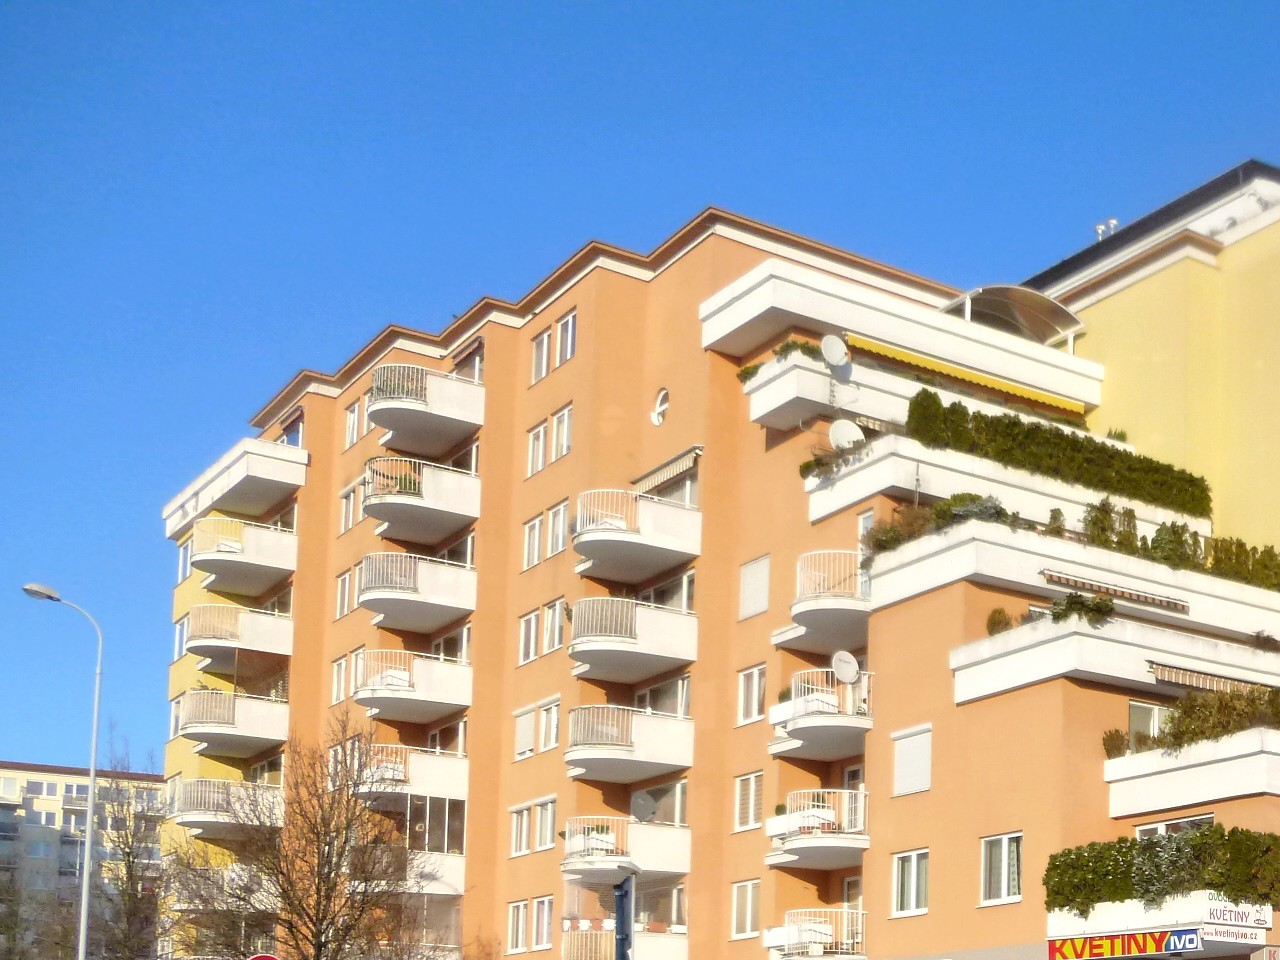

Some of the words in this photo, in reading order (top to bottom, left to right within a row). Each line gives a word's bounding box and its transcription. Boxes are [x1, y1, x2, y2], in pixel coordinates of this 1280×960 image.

[1209, 906, 1250, 923] KVĚTINY
[1049, 931, 1170, 960] KVĚTINY
[1170, 934, 1197, 950] IVO
